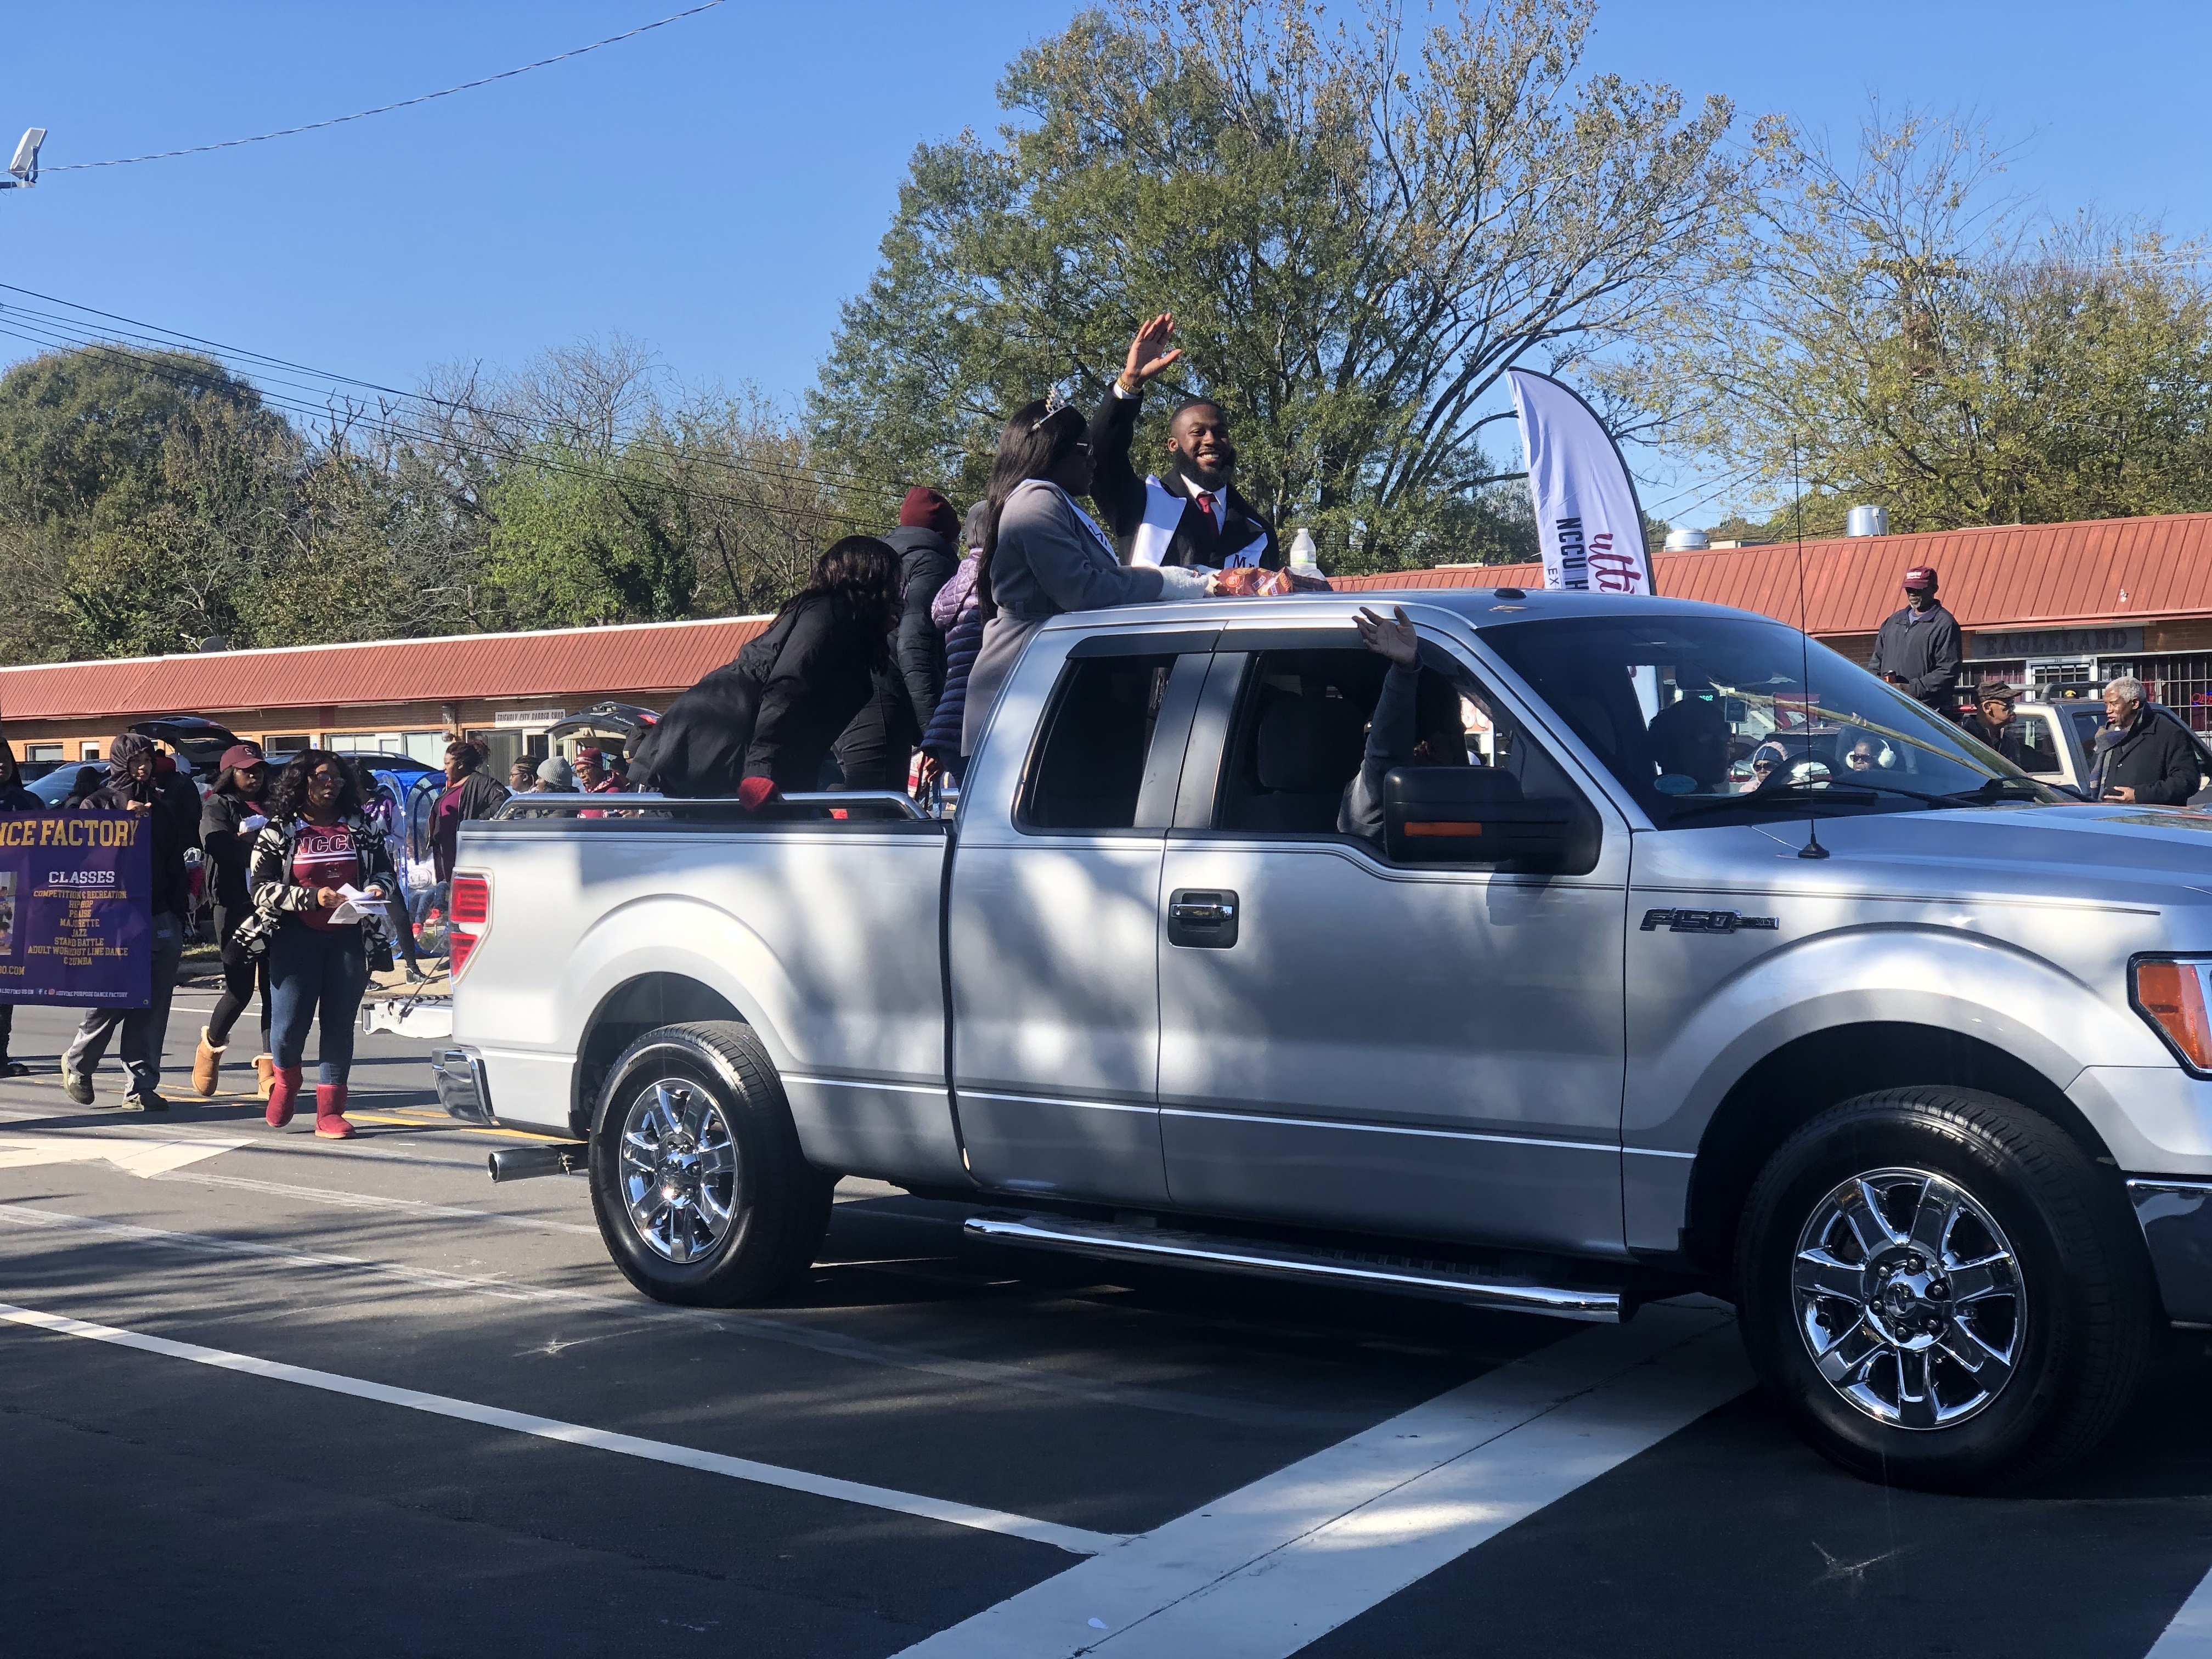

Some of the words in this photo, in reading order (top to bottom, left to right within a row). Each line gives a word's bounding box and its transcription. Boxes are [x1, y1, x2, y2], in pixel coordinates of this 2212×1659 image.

[1556, 517, 1587, 569] NCCU
[1548, 567, 1560, 589] EX
[1985, 629, 2127, 655] EAGLELAND
[519, 713, 530, 722] CITY
[40, 819, 139, 846] FACTORY
[49, 871, 115, 884] CLASSES
[33, 889, 81, 899] COMPETITION
[87, 890, 127, 899] RECREATION
[69, 900, 81, 909] HIP
[69, 910, 92, 918] PRAISE
[60, 918, 100, 927] MAJORETTE
[71, 928, 87, 937] JAZZ
[54, 937, 77, 946] STAND
[77, 938, 104, 946] BATTLE
[28, 946, 52, 954] ADULT
[53, 946, 86, 956] WORKOUT
[105, 947, 128, 956] DANCE
[69, 957, 92, 965] ZUMBA
